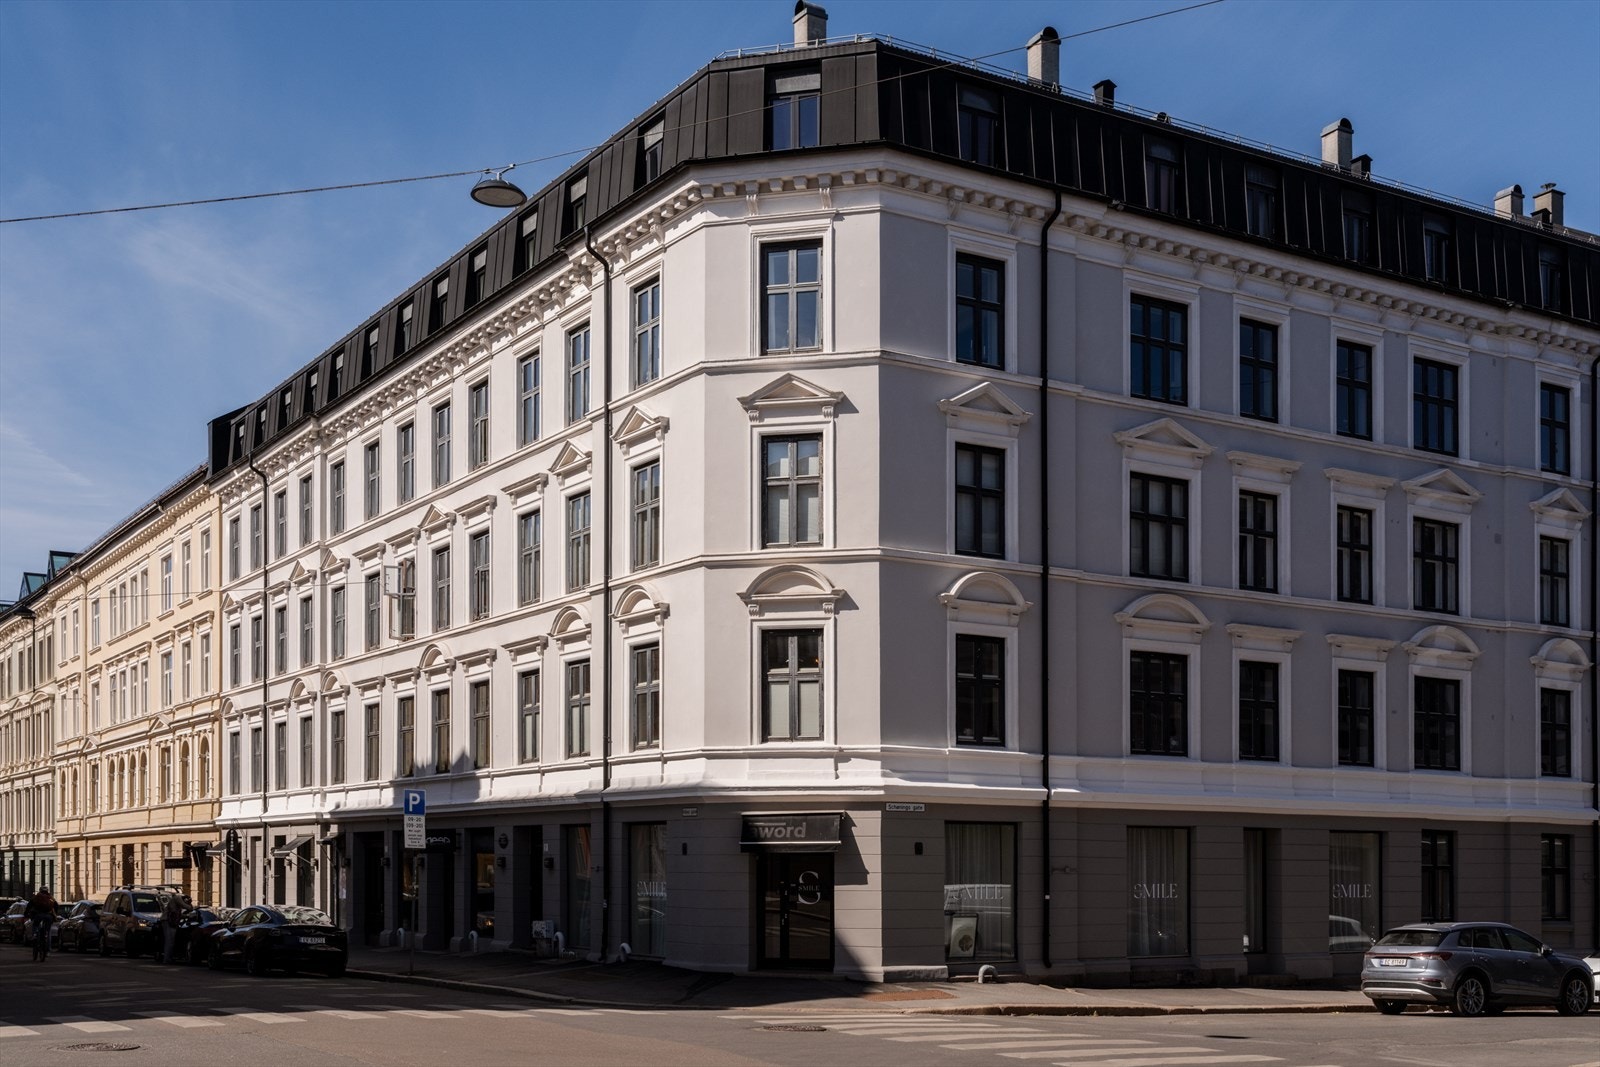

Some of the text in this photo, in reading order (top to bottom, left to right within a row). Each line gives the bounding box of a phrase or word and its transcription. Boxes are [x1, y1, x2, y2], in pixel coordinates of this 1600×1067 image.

[409, 793, 420, 811] P
[1133, 883, 1178, 899] SMILE
[1332, 884, 1372, 899] SMILE
